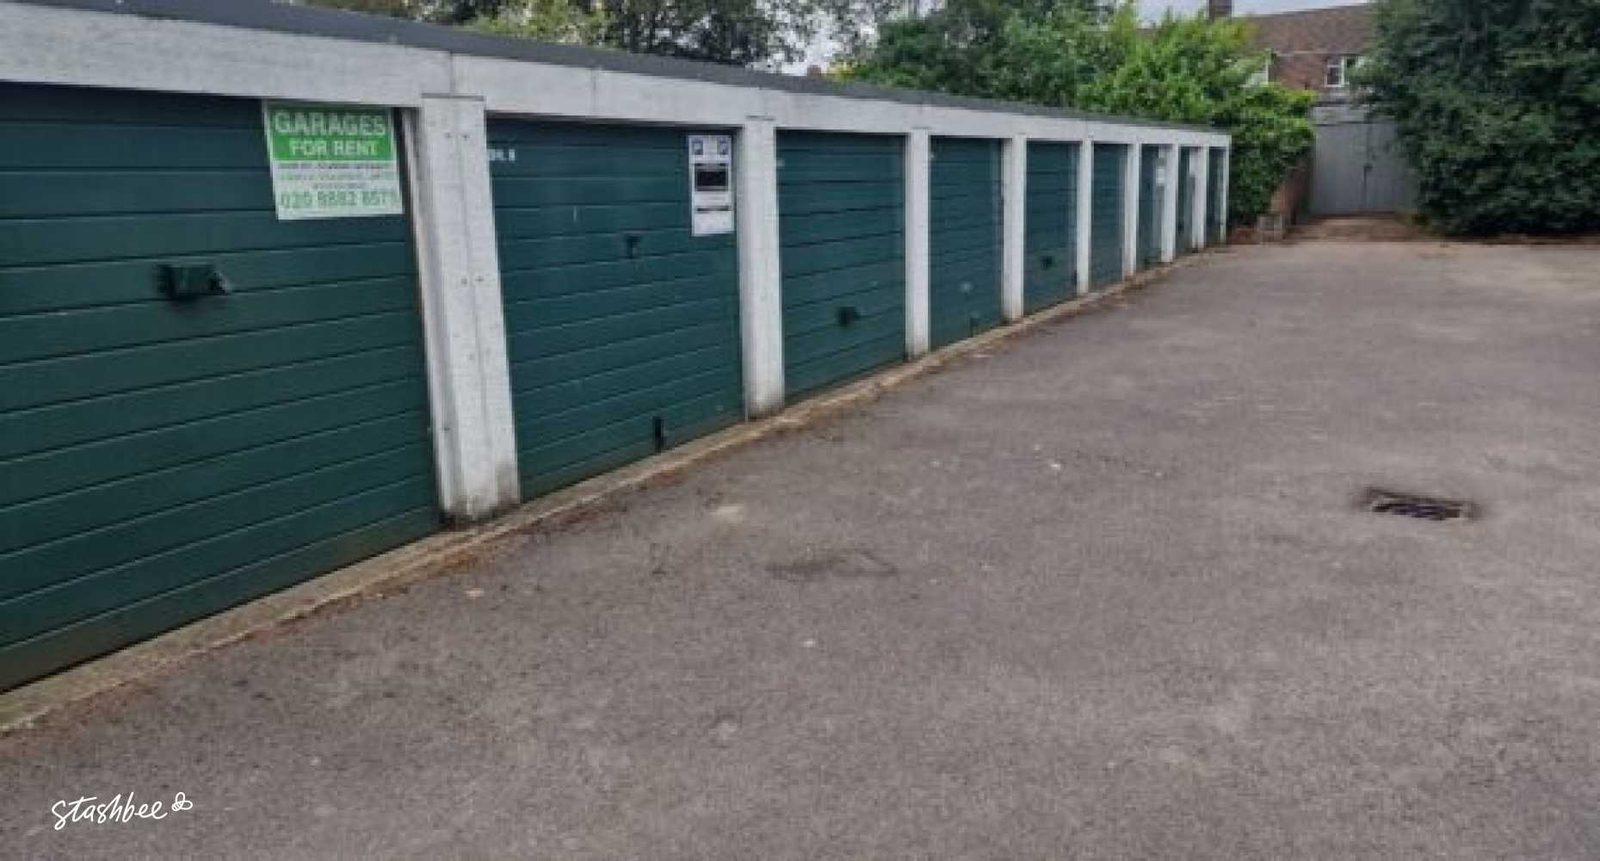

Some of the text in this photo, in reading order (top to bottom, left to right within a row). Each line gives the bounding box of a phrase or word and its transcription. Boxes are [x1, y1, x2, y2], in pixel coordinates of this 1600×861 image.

[274, 111, 386, 136] GARAGES
[288, 139, 379, 157] FOR RENT
